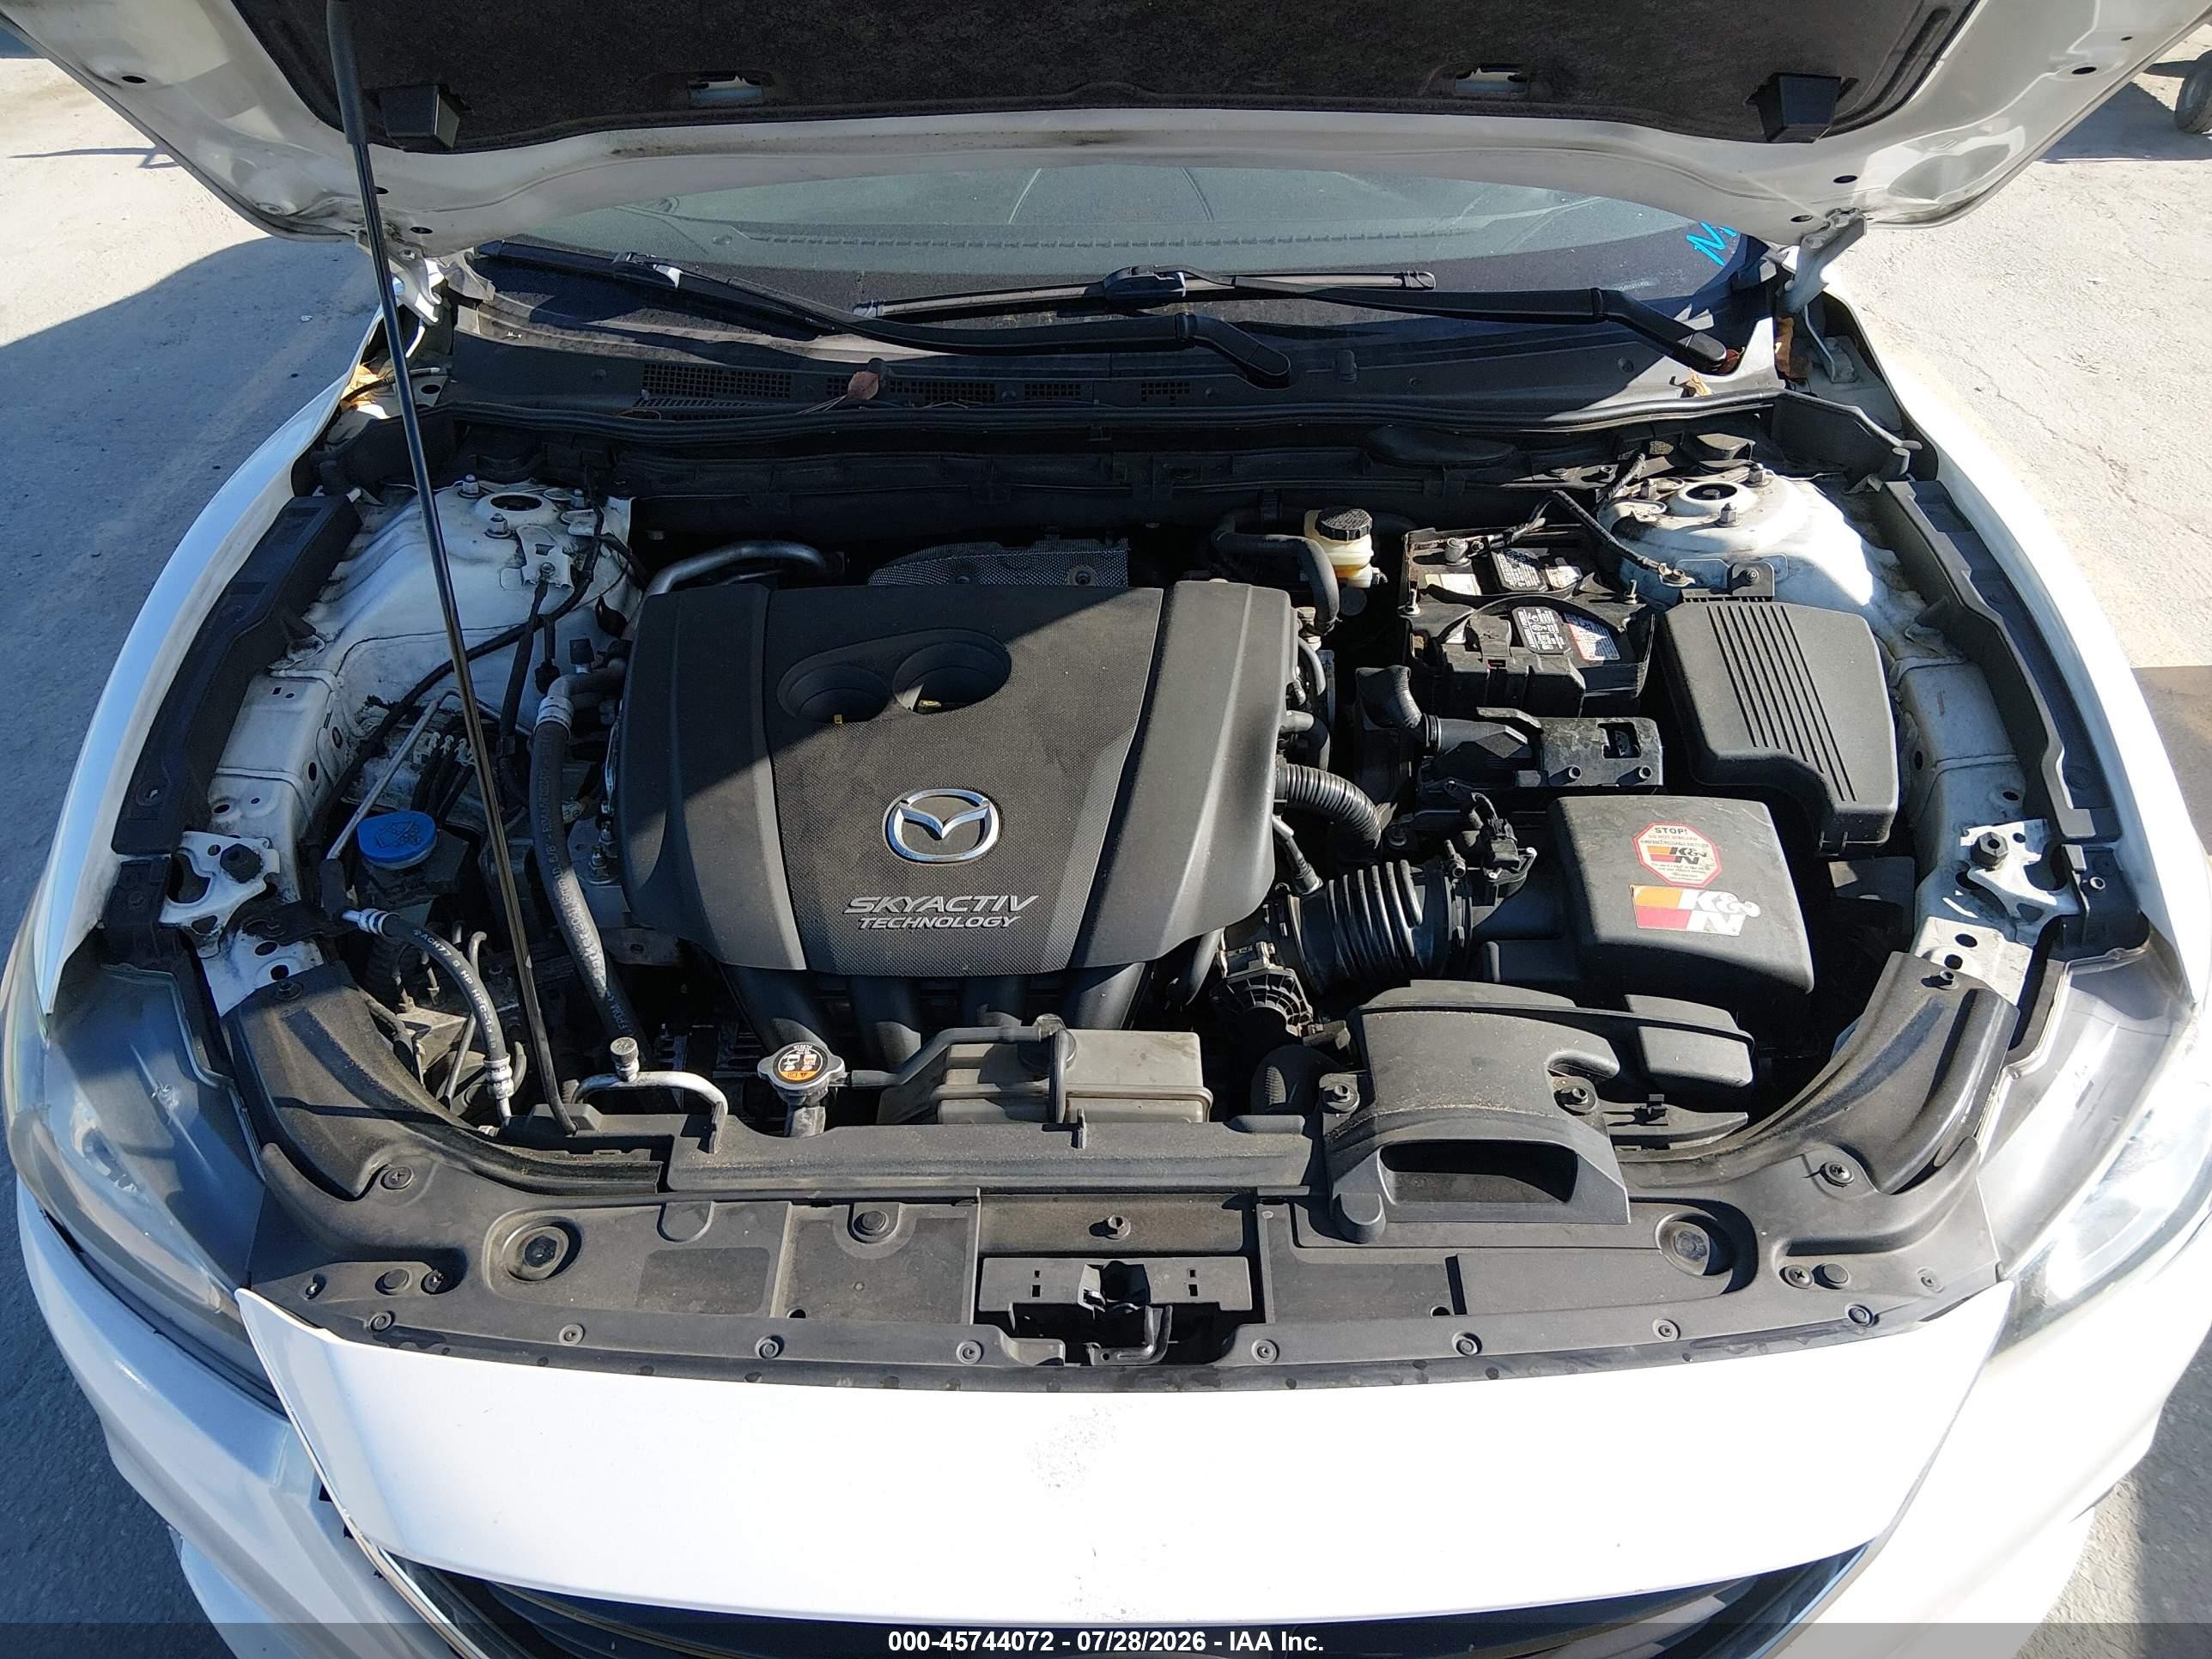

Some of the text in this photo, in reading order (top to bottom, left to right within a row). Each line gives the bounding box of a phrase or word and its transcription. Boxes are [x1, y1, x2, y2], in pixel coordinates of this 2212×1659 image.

[843, 895, 1040, 914] SKYACTIV
[1676, 888, 1760, 936] K&N
[859, 915, 1022, 930] TECHNOLOGY
